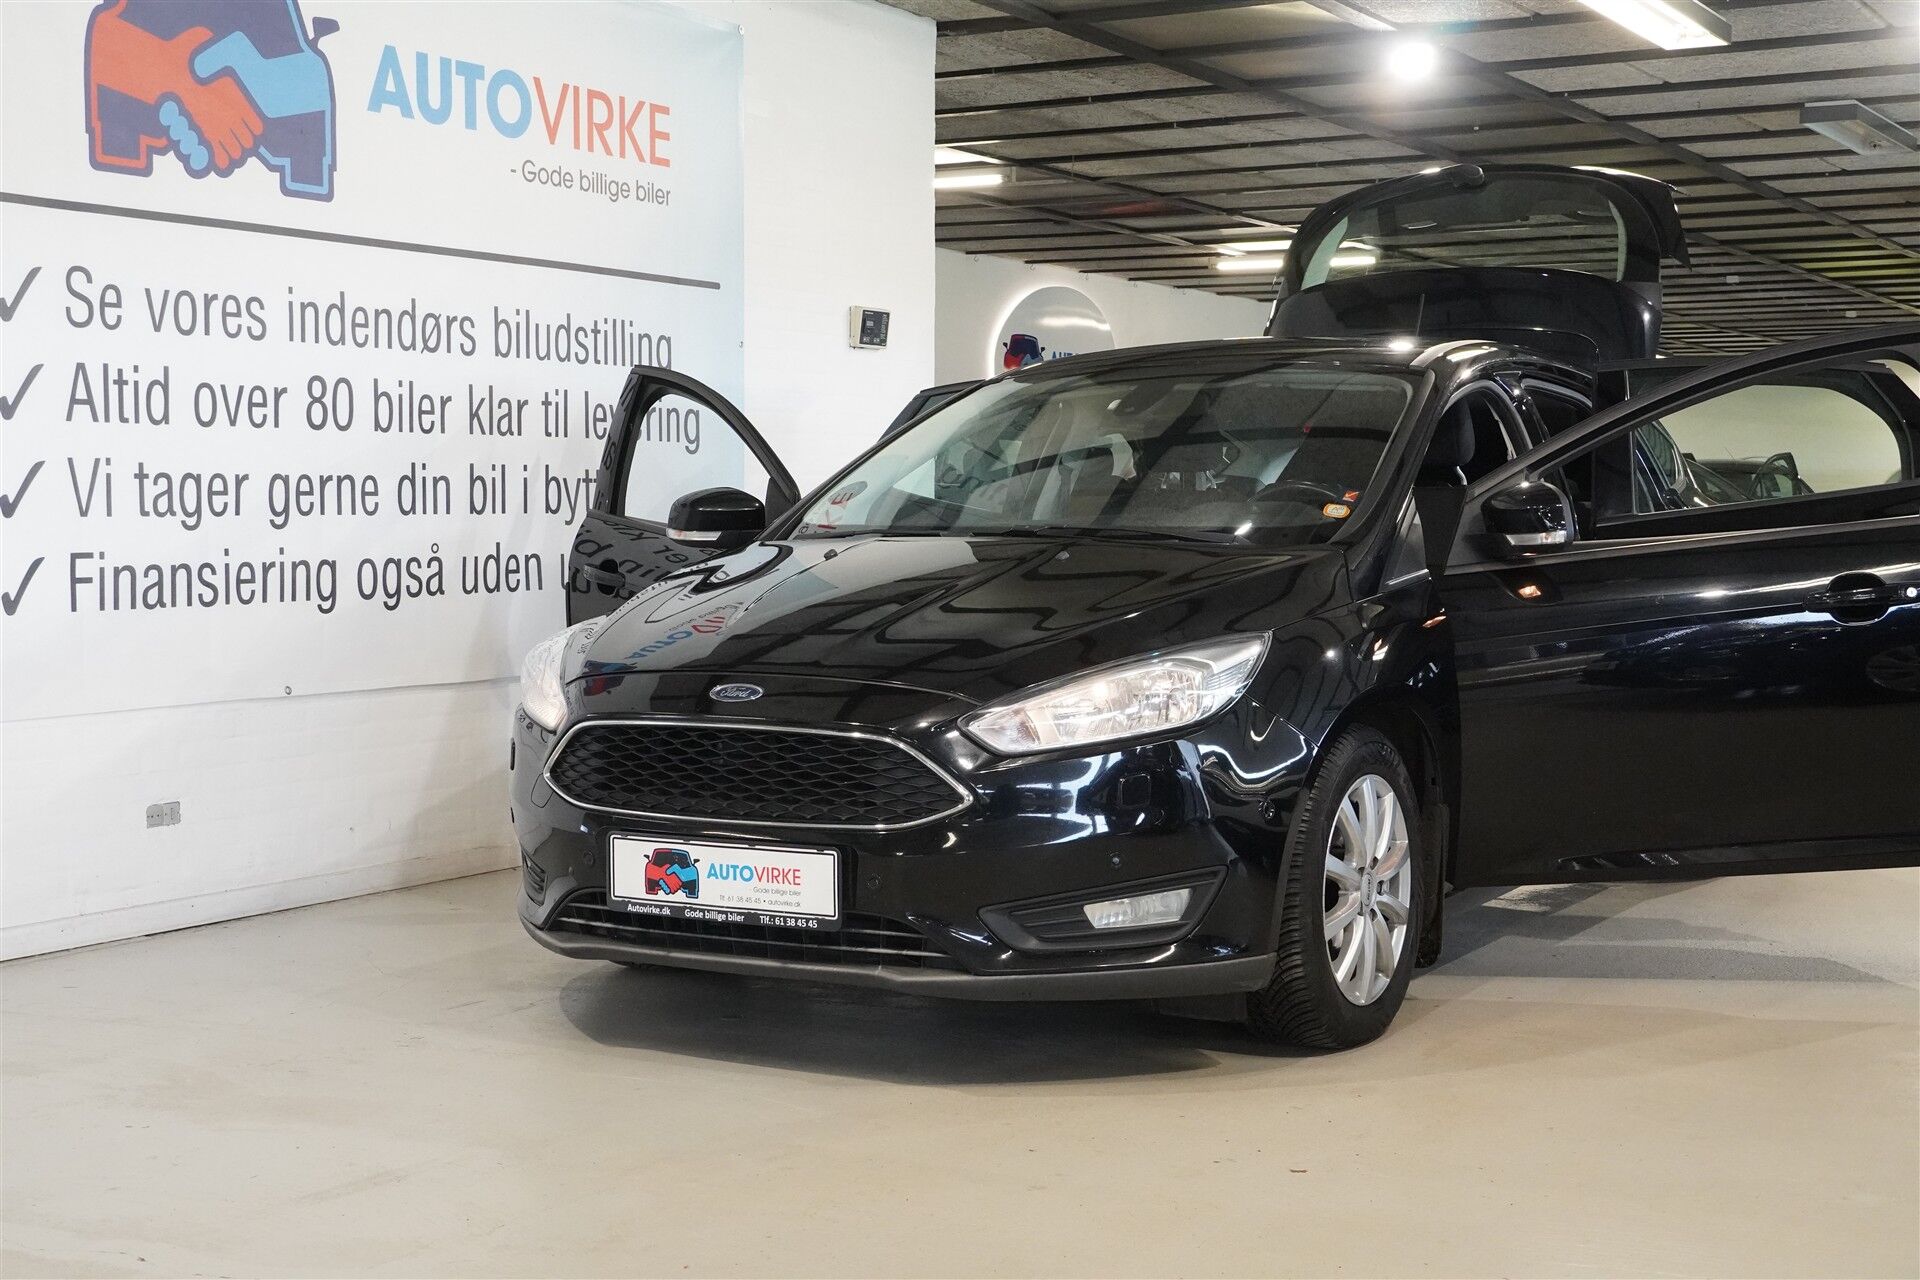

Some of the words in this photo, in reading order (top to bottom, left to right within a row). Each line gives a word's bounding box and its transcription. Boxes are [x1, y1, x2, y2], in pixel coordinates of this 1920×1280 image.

[367, 44, 671, 168] AUTOVIRKE
[521, 159, 574, 190] Gode
[579, 168, 631, 203] billige
[635, 179, 671, 206] biler
[65, 265, 123, 331] Se
[144, 287, 267, 342] vores
[287, 286, 477, 357] indendørs
[493, 305, 672, 370] biludstilling
[65, 361, 171, 427] Altid
[193, 381, 288, 430] over
[305, 374, 355, 432] 80
[373, 377, 453, 435] biler
[468, 383, 529, 438] klar
[541, 387, 569, 439] til
[66, 456, 113, 518] Vi
[133, 463, 250, 532] tager
[268, 472, 380, 532] gerne
[397, 462, 451, 517] din
[469, 462, 507, 516] bil
[523, 464, 528, 514] i
[69, 546, 337, 615] Finansiering
[356, 542, 446, 611] også
[461, 541, 544, 596] uden
[707, 863, 801, 886] AUTOVIRKE
[627, 903, 671, 916] Autovirke.dk
[684, 909, 703, 918] Gode
[704, 910, 727, 921] billige
[728, 912, 745, 922] biler
[775, 917, 784, 926] 61
[786, 918, 796, 927] 38
[797, 919, 807, 928] 45
[807, 920, 818, 929] 45
